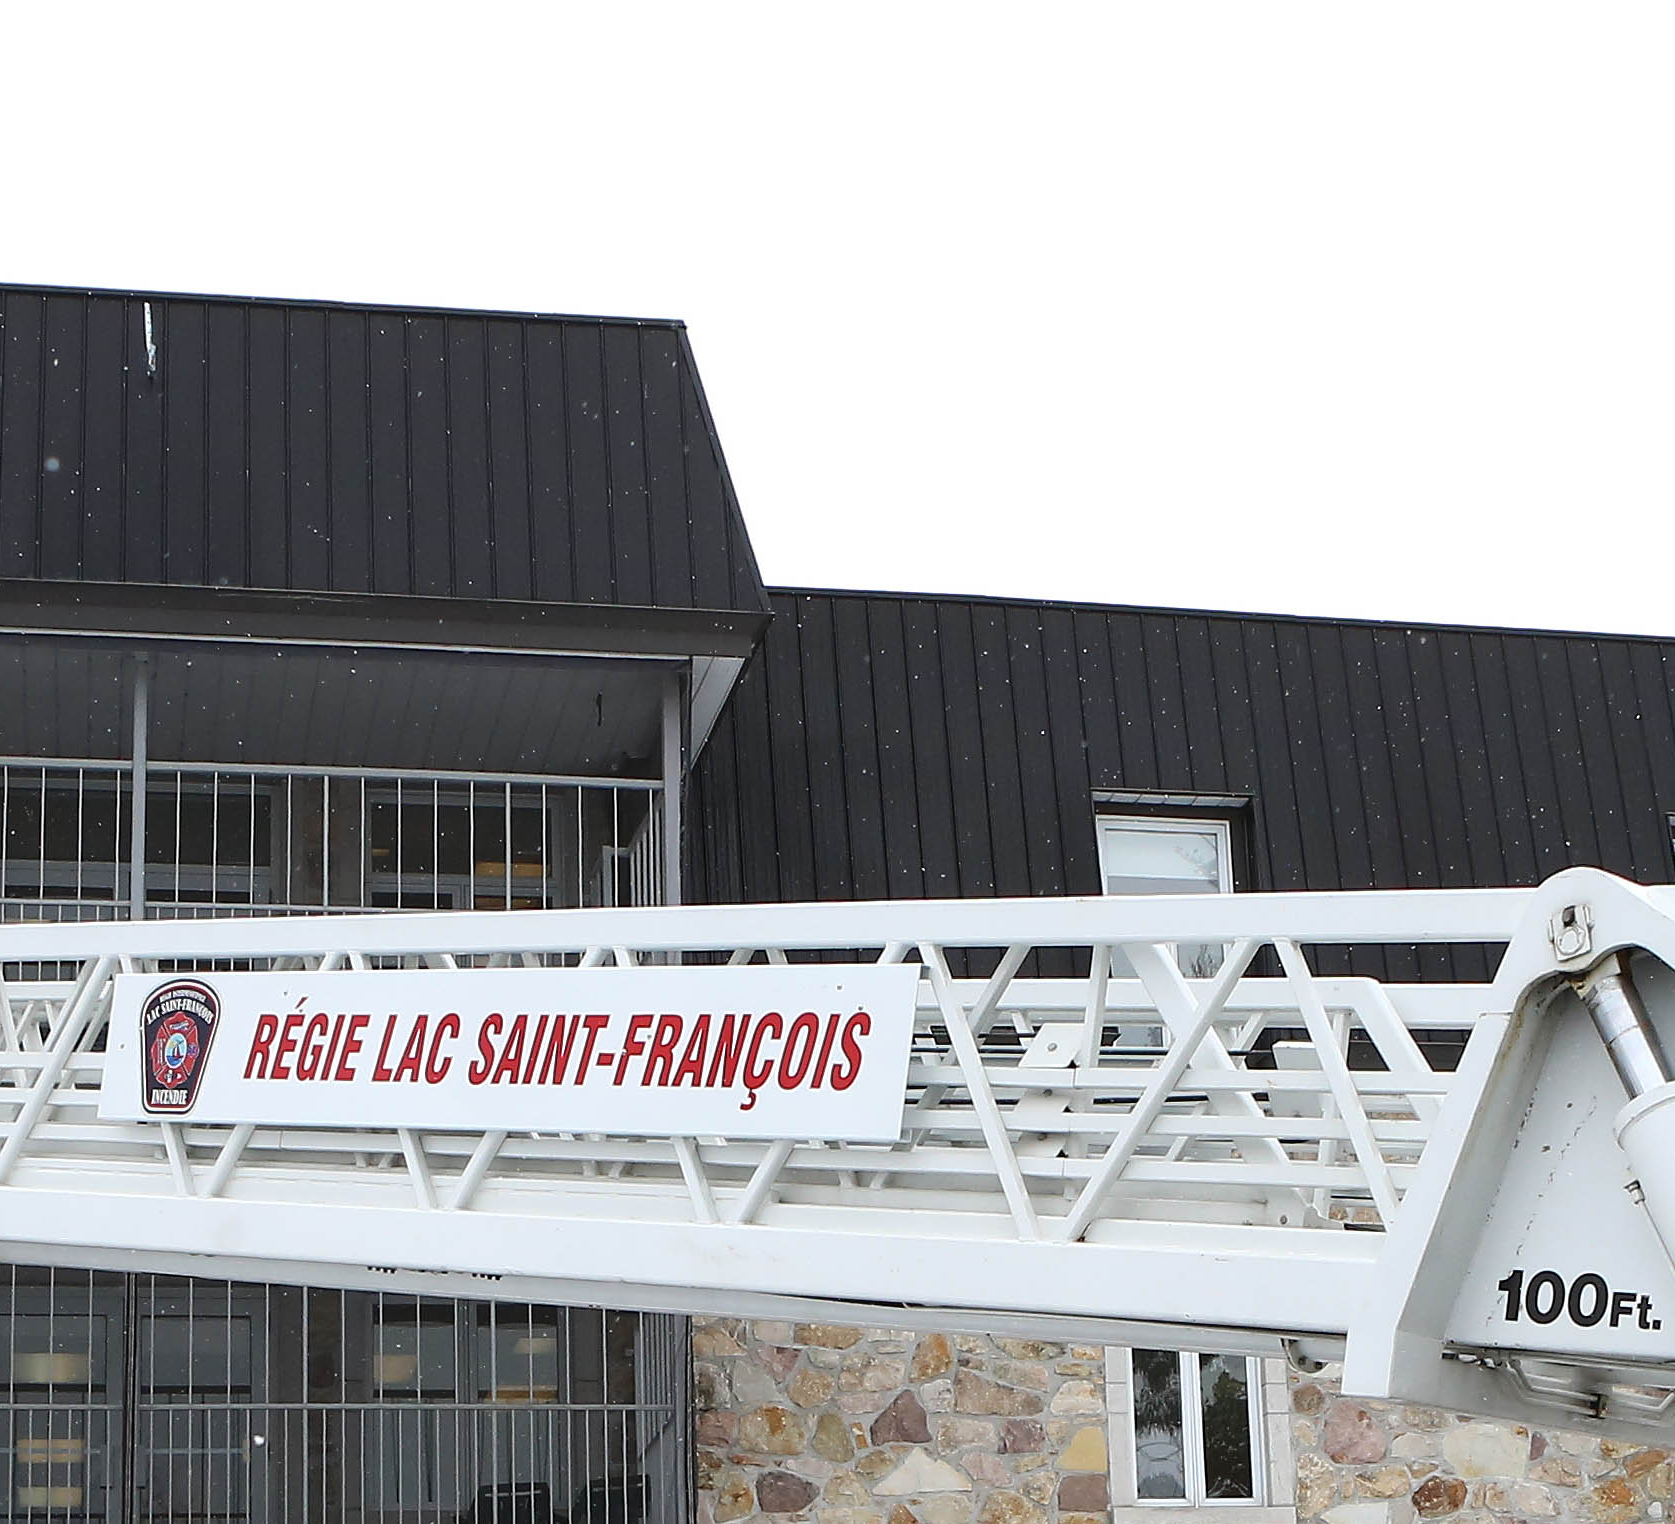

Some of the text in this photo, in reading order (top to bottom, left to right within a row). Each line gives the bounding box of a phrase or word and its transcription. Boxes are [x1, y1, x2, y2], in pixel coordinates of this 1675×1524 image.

[243, 997, 872, 1111] RÉGIE LAC SAINT-FRANÇOIS
[151, 1089, 188, 1105] INCENDIE
